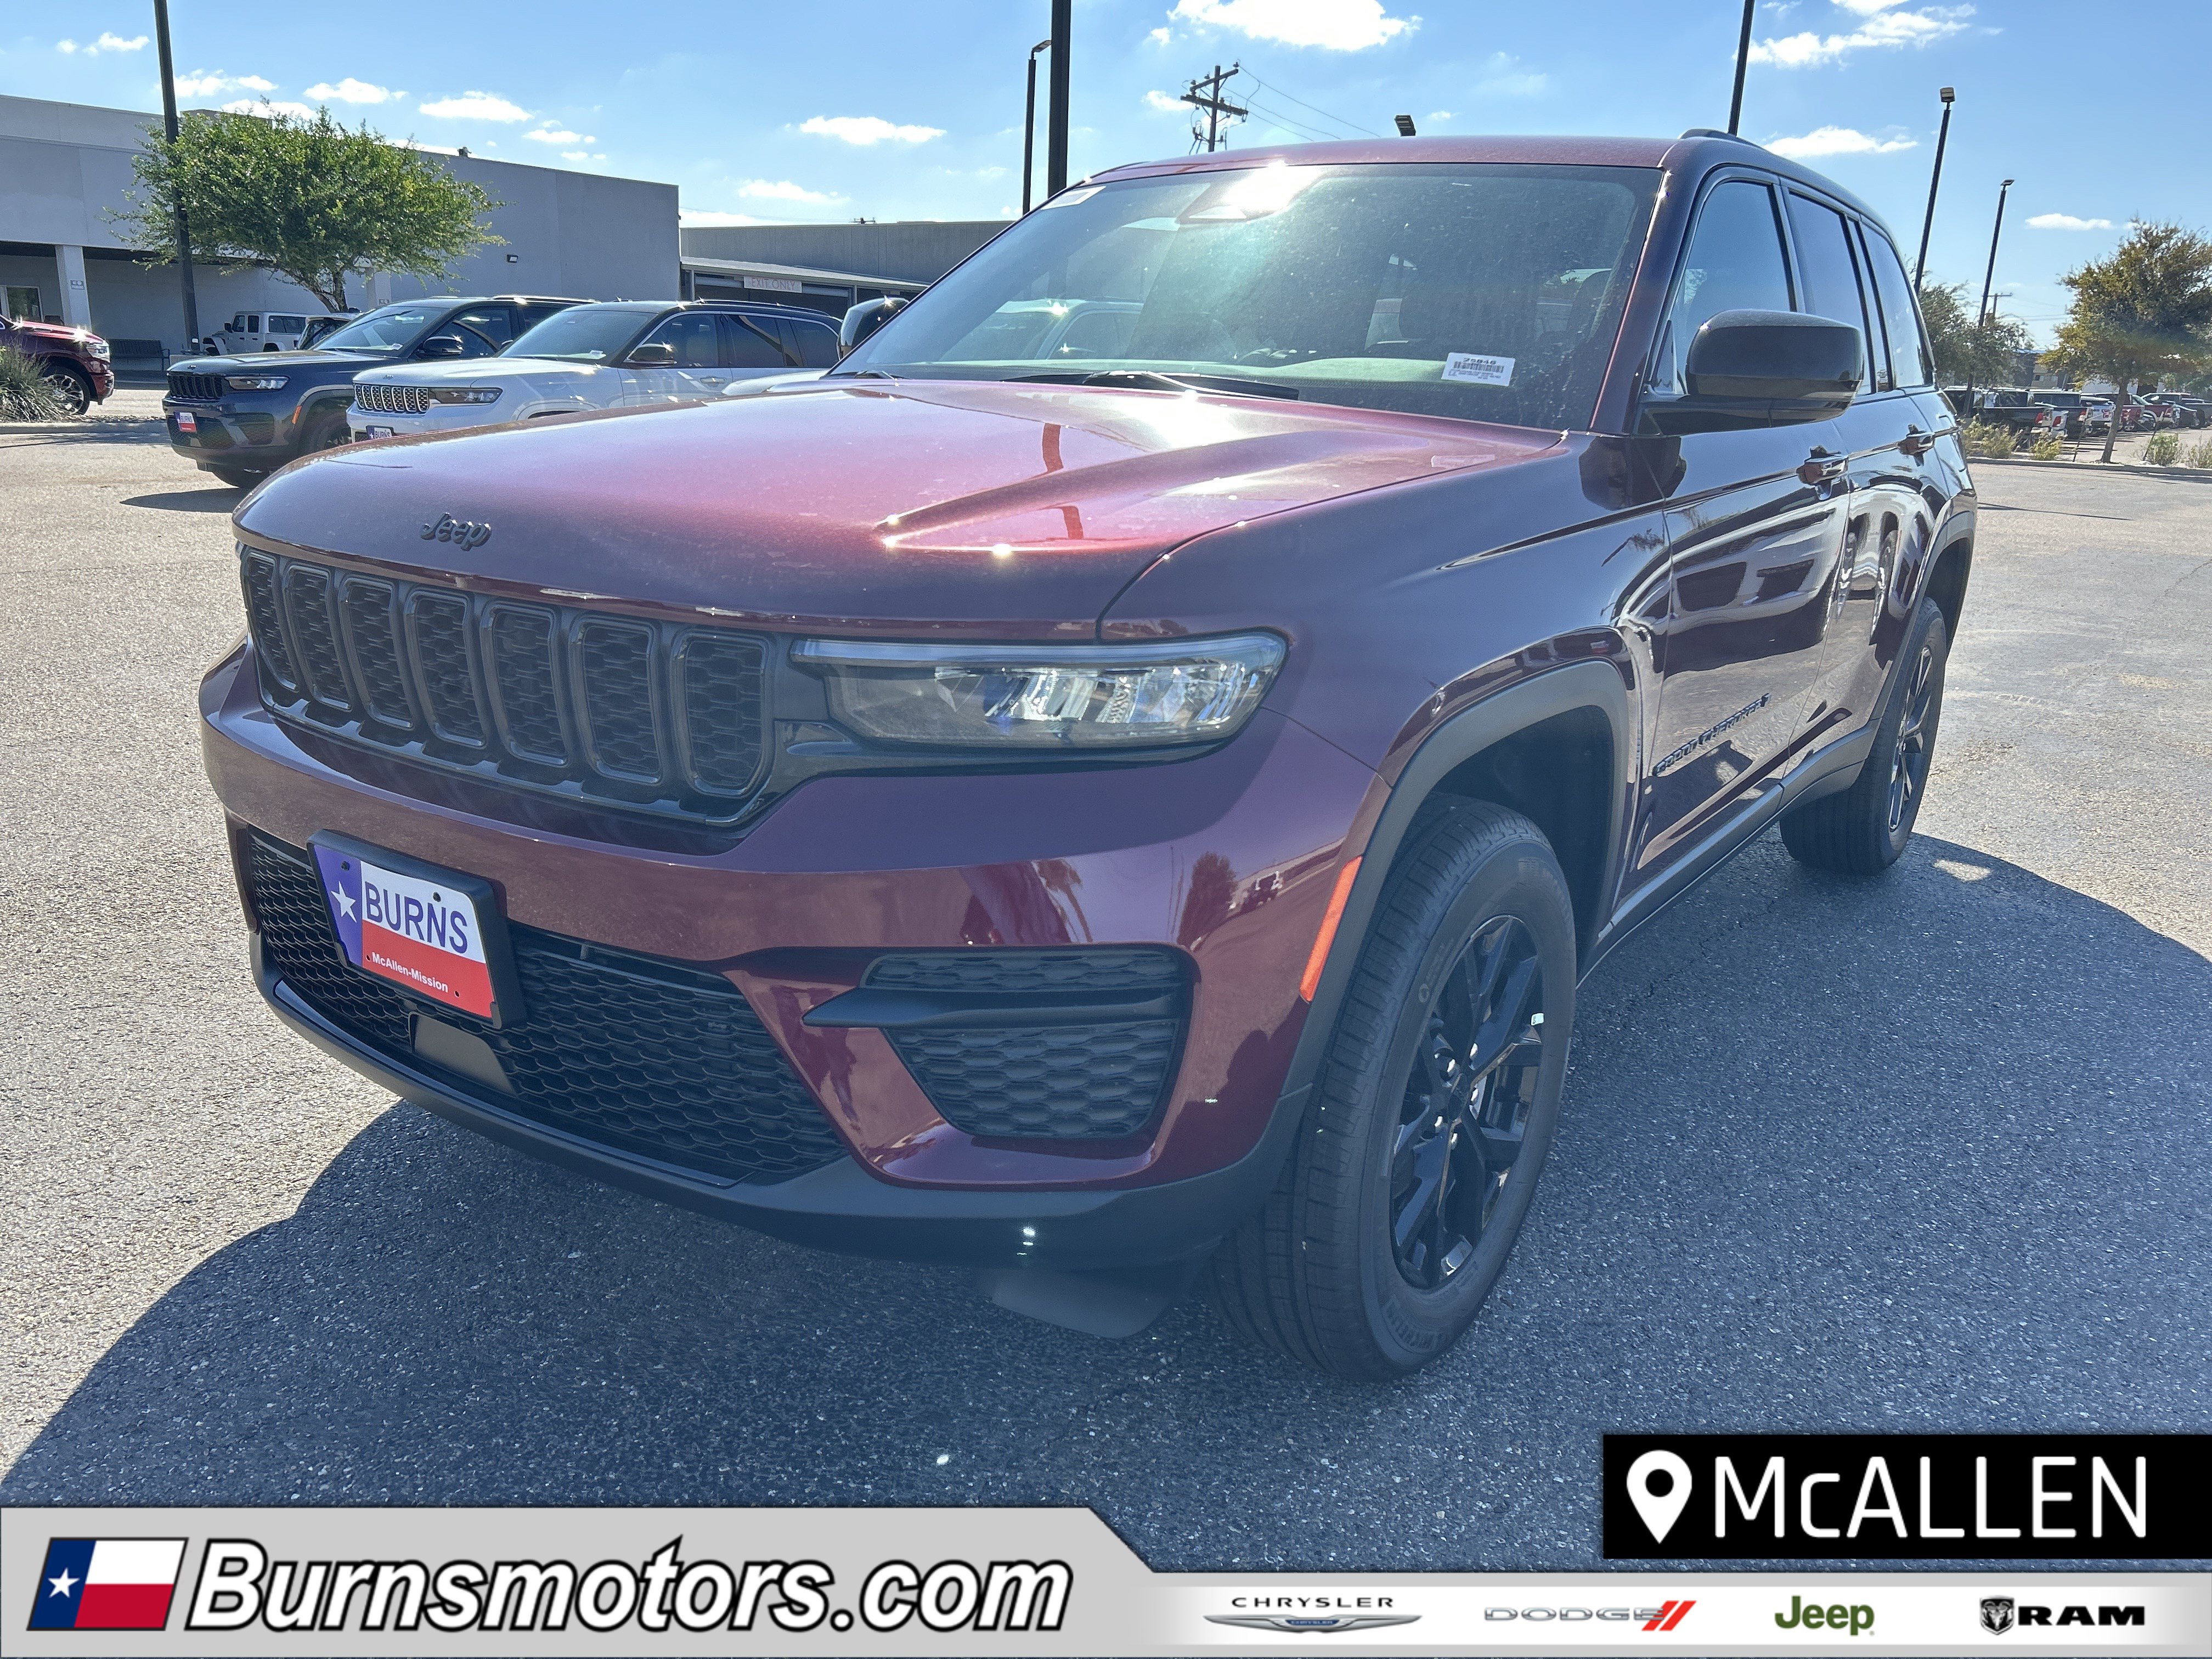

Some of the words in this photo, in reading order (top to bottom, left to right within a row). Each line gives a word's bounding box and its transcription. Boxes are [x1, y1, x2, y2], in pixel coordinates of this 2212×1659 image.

[751, 278, 769, 288] EXIT
[772, 279, 795, 291] ONLY
[420, 512, 492, 552] Jeep
[364, 881, 468, 954] BURNS
[372, 952, 449, 993] McAllen-Mission
